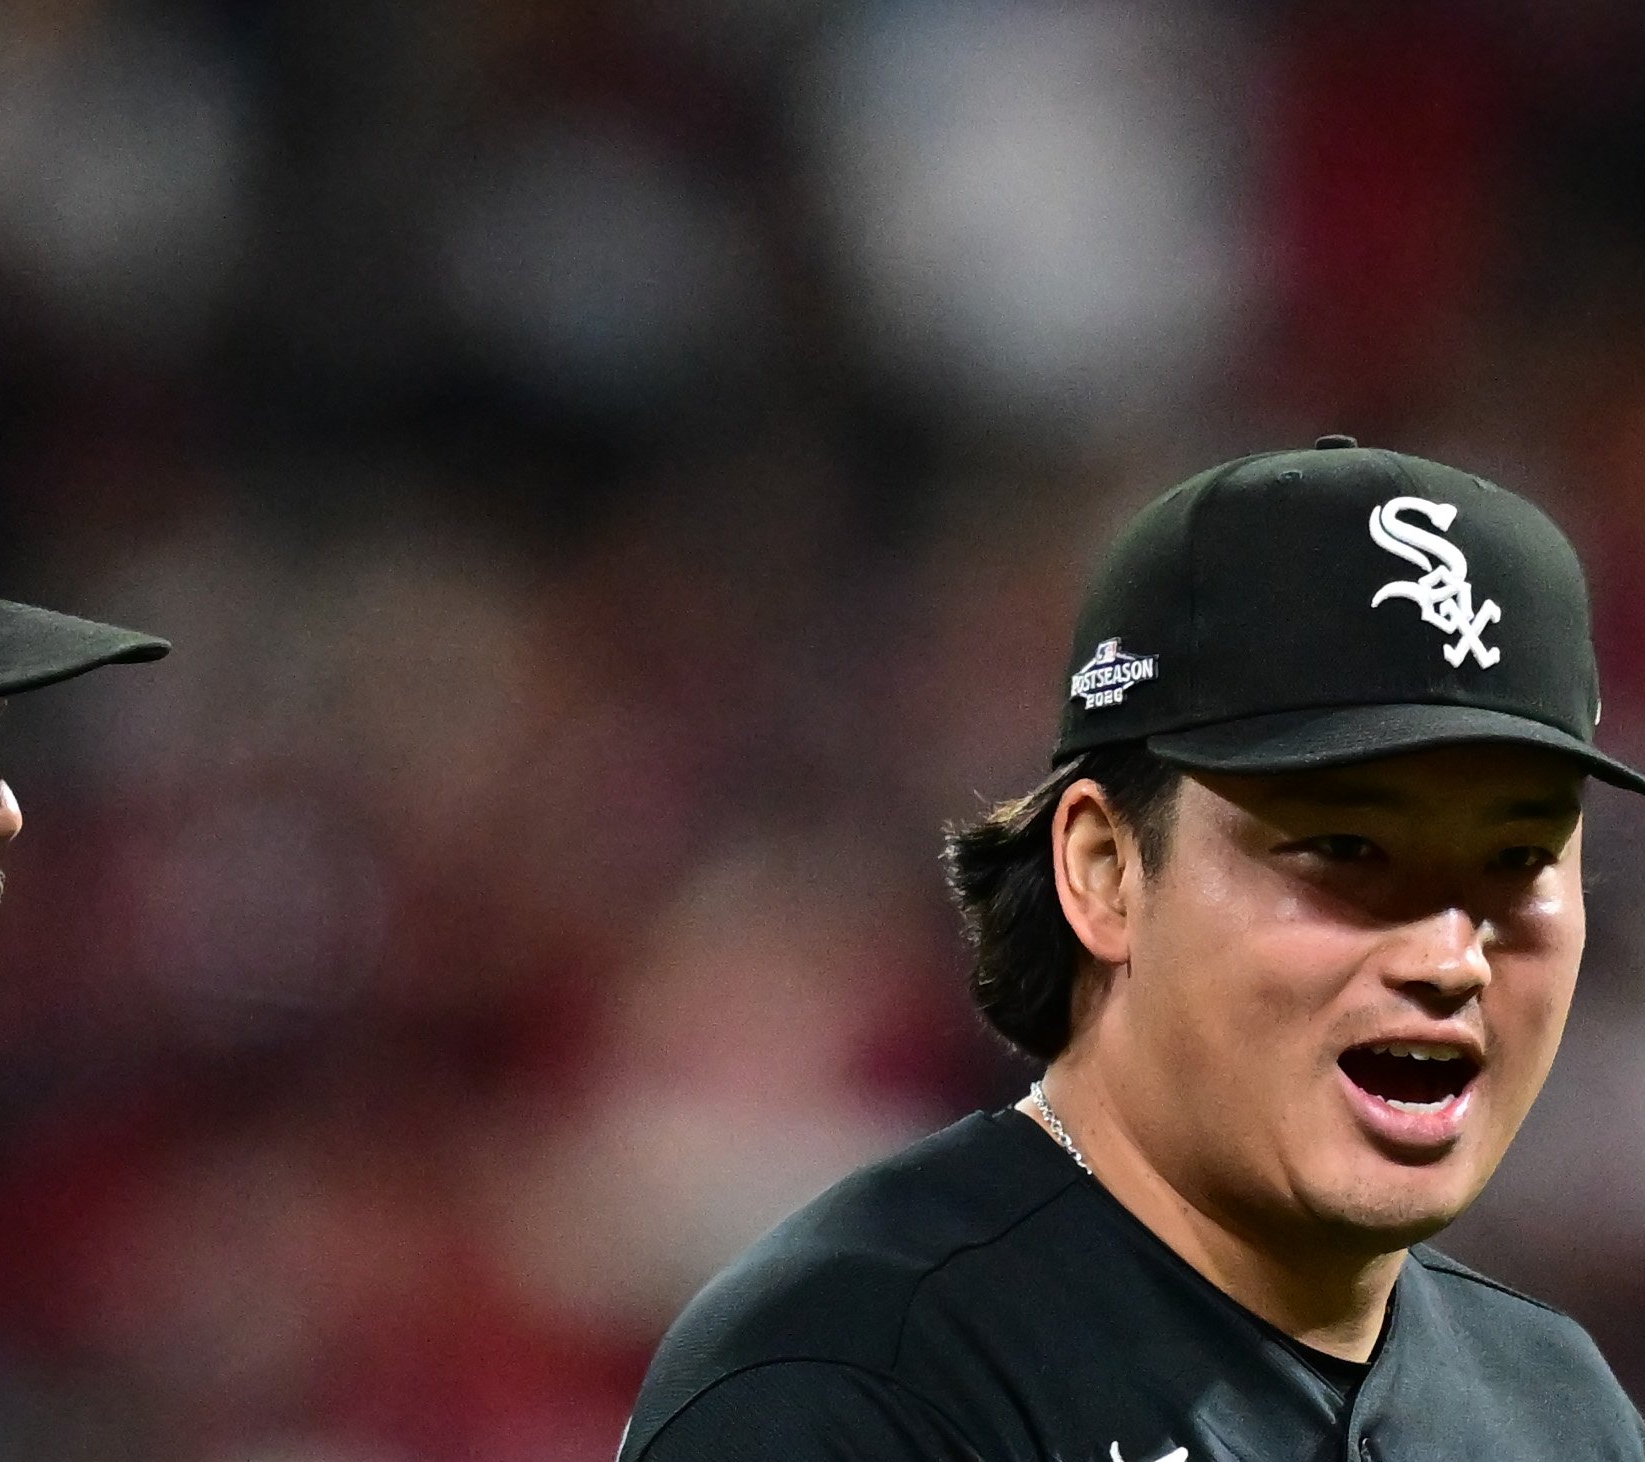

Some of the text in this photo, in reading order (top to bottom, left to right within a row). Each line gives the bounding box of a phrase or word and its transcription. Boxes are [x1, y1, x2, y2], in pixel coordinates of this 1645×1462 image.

[1369, 497, 1501, 669] Sox
[1070, 658, 1154, 697] POSTSEASON
[1085, 687, 1124, 709] 2026
